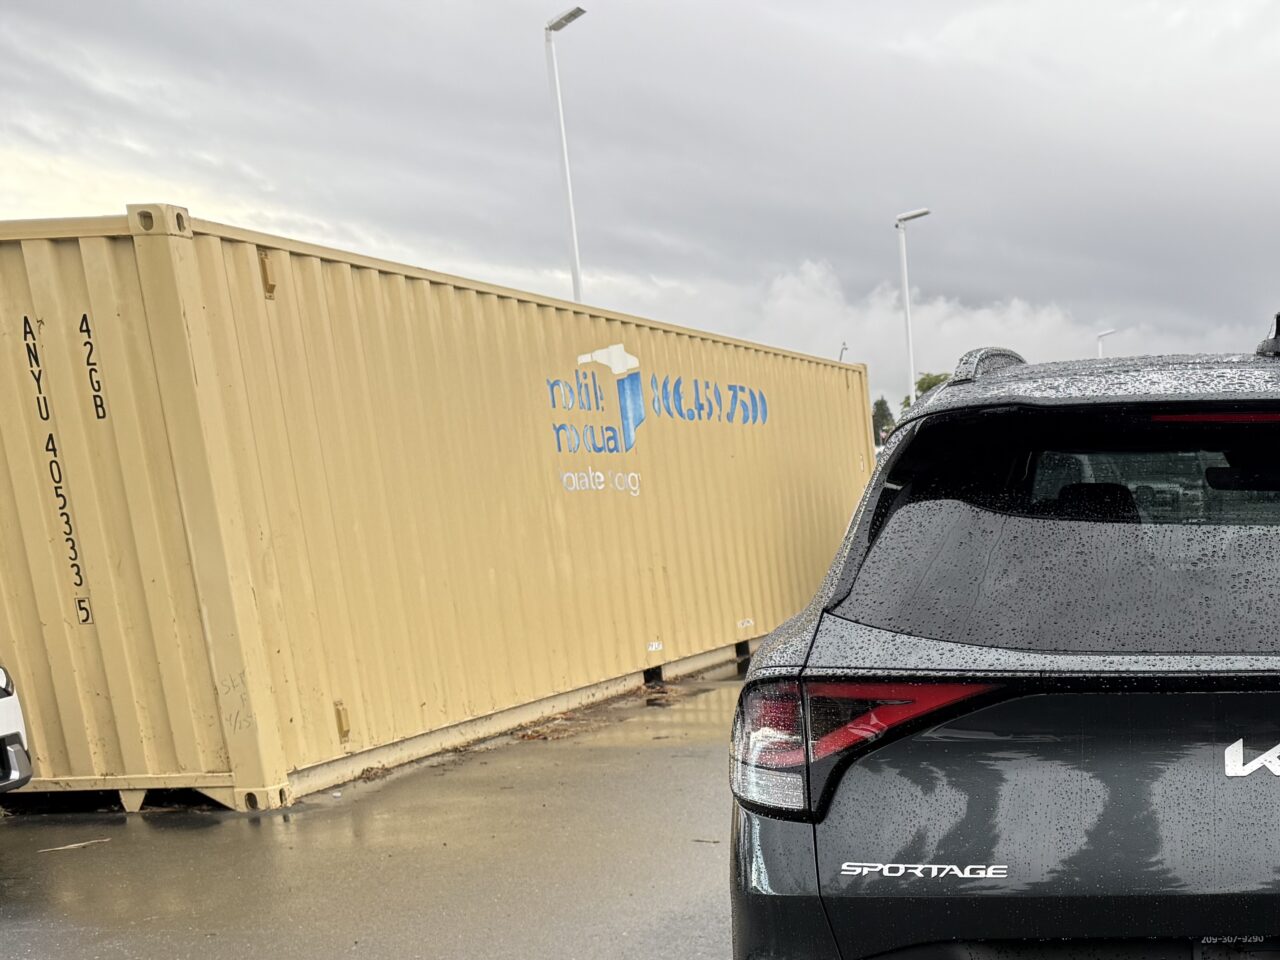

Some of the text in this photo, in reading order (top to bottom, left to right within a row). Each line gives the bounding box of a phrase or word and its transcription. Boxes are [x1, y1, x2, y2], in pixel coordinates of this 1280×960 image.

[79, 313, 107, 419] 42GB
[23, 315, 92, 623] ANYU 405333 5
[840, 862, 1008, 878] SPORTAGE
